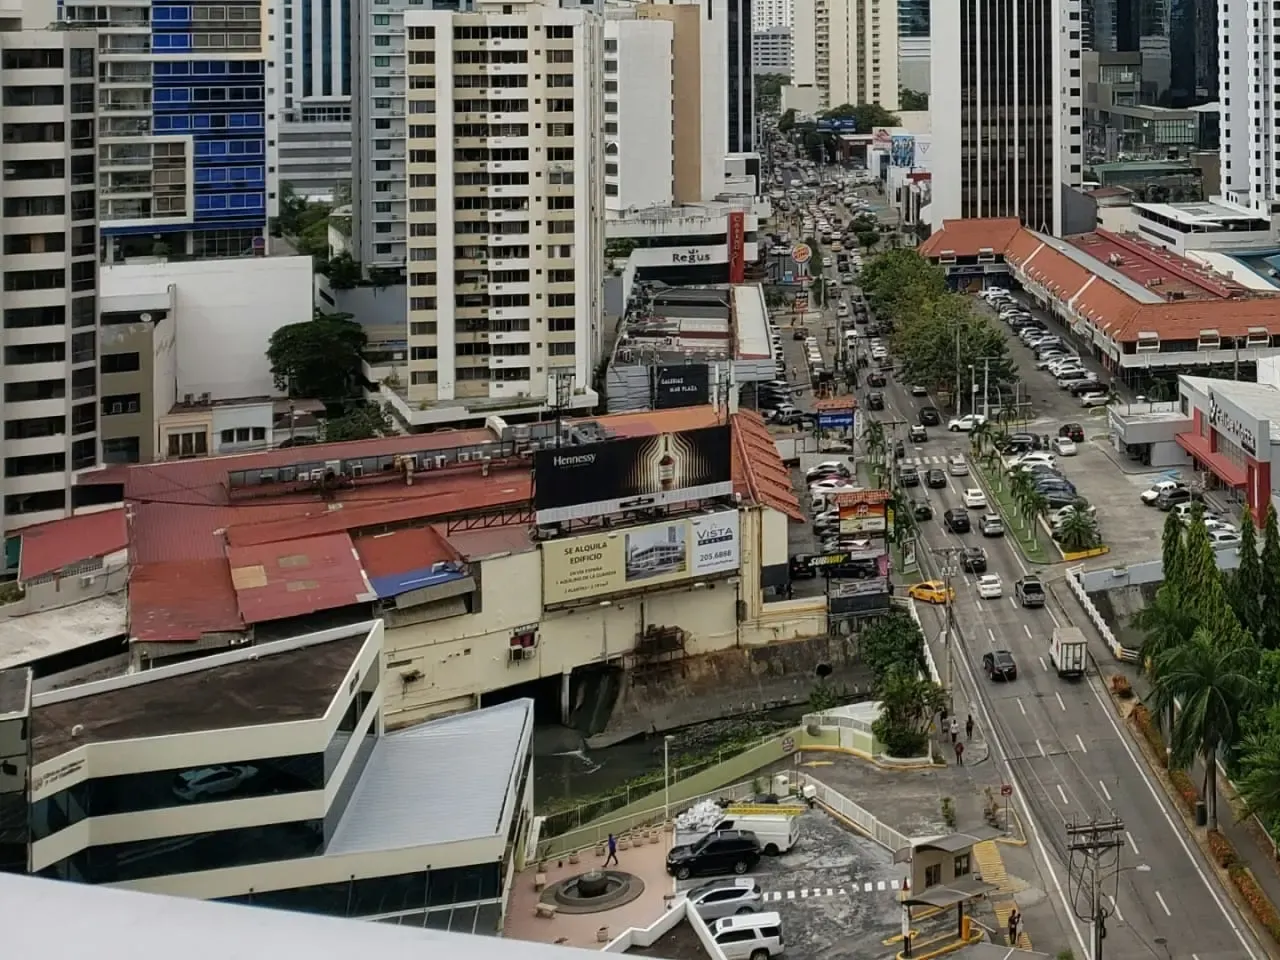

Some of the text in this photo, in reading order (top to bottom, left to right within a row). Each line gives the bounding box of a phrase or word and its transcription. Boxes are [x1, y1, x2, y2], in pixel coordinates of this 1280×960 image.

[672, 253, 710, 263] Regus
[553, 453, 597, 467] Hennessy
[697, 527, 733, 539] VISTA
[564, 542, 607, 555] SE ALQUILA
[570, 553, 602, 564] EDIFICIO
[808, 554, 848, 566] SUBWAY
